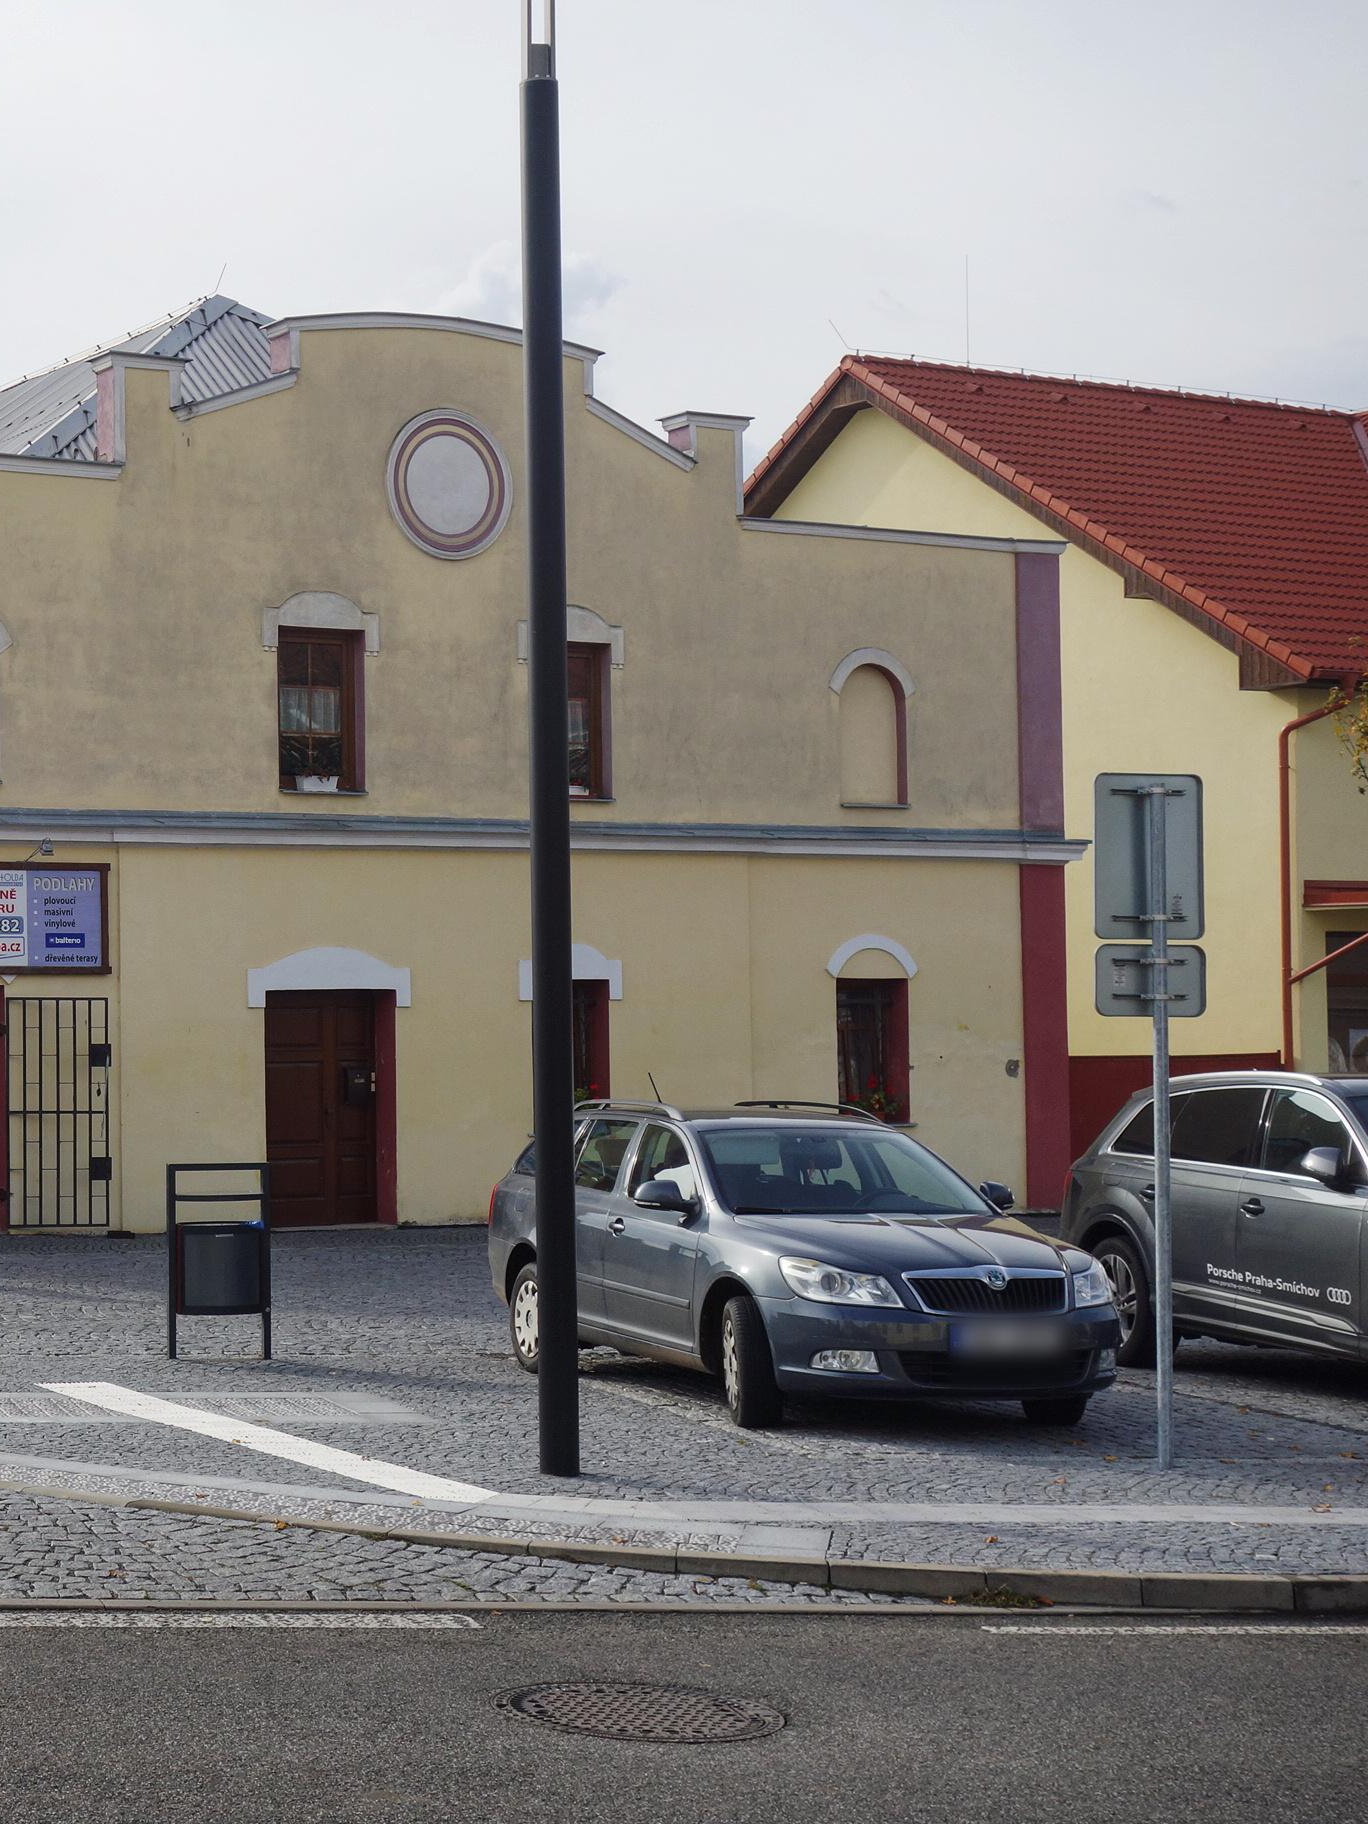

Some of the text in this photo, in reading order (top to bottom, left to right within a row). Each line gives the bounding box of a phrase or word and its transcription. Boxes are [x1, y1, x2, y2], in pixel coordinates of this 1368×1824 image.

[33, 877, 95, 891] PODLAHY
[44, 896, 76, 906] plovoucí
[44, 908, 73, 916] masivní
[44, 919, 76, 929] vinylové
[44, 953, 98, 964] dřevěné terasy
[1206, 1263, 1320, 1298] Porsche Praha-Smíchov
